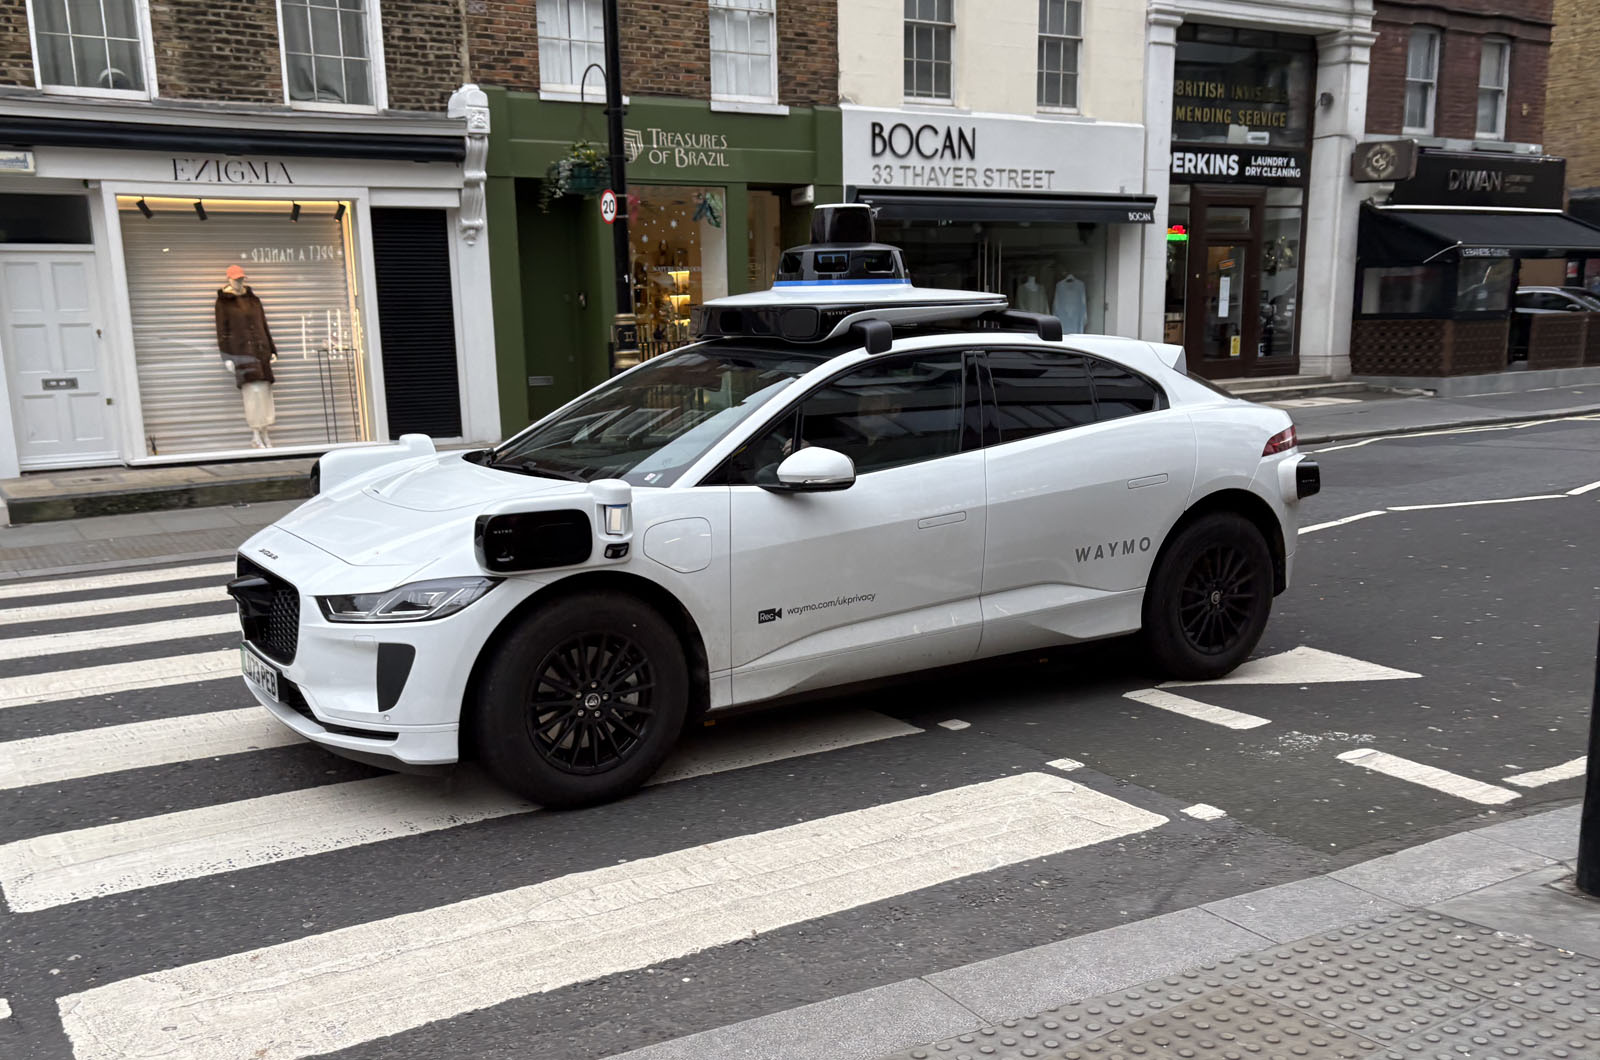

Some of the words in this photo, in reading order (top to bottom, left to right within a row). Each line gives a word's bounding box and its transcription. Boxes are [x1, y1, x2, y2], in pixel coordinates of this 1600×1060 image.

[1175, 79, 1225, 99] BRITISH
[1174, 105, 1232, 124] MENDING
[1237, 109, 1287, 127] SERVICE
[870, 121, 977, 161] BOCAN
[1250, 155, 1289, 167] LAUNDRY
[1289, 157, 1296, 168] &
[872, 164, 894, 185] 33
[899, 165, 979, 188] THAYER
[982, 168, 1056, 191] STREET
[1244, 166, 1263, 177] DRY
[1262, 167, 1302, 179] CLEANING
[602, 199, 616, 215] 20
[1128, 211, 1152, 221] BOCAN
[1075, 536, 1151, 563] WAYMO
[760, 612, 775, 622] Rec
[786, 593, 876, 616] waymo.com/ukprivacy
